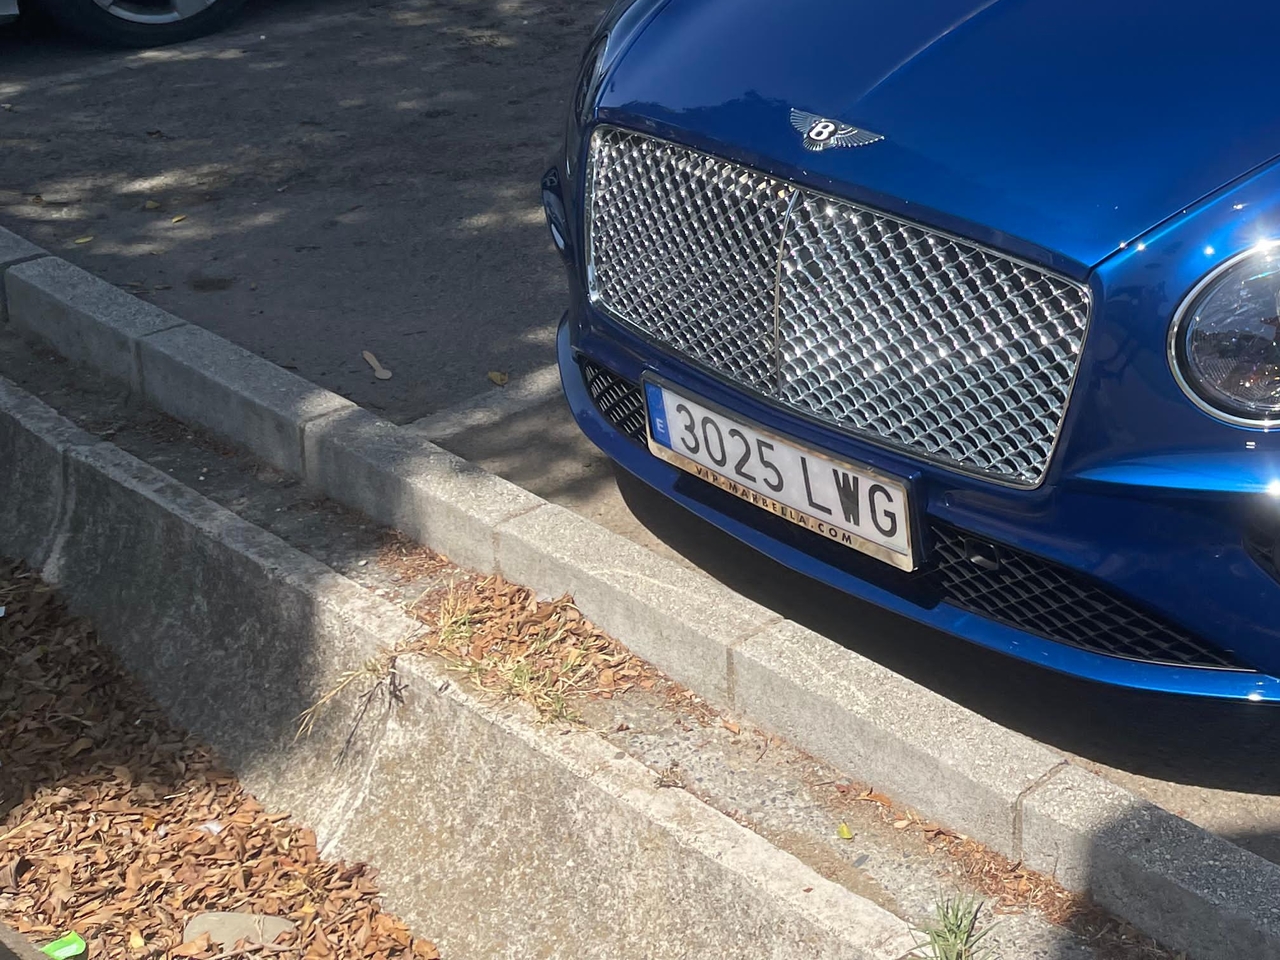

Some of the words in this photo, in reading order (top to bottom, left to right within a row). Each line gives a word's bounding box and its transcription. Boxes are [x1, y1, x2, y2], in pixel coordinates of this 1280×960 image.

[655, 419, 665, 434] E
[676, 403, 784, 493] 3025
[800, 457, 898, 538] LWG
[695, 465, 853, 545] VIP-MARBELLA.COM
